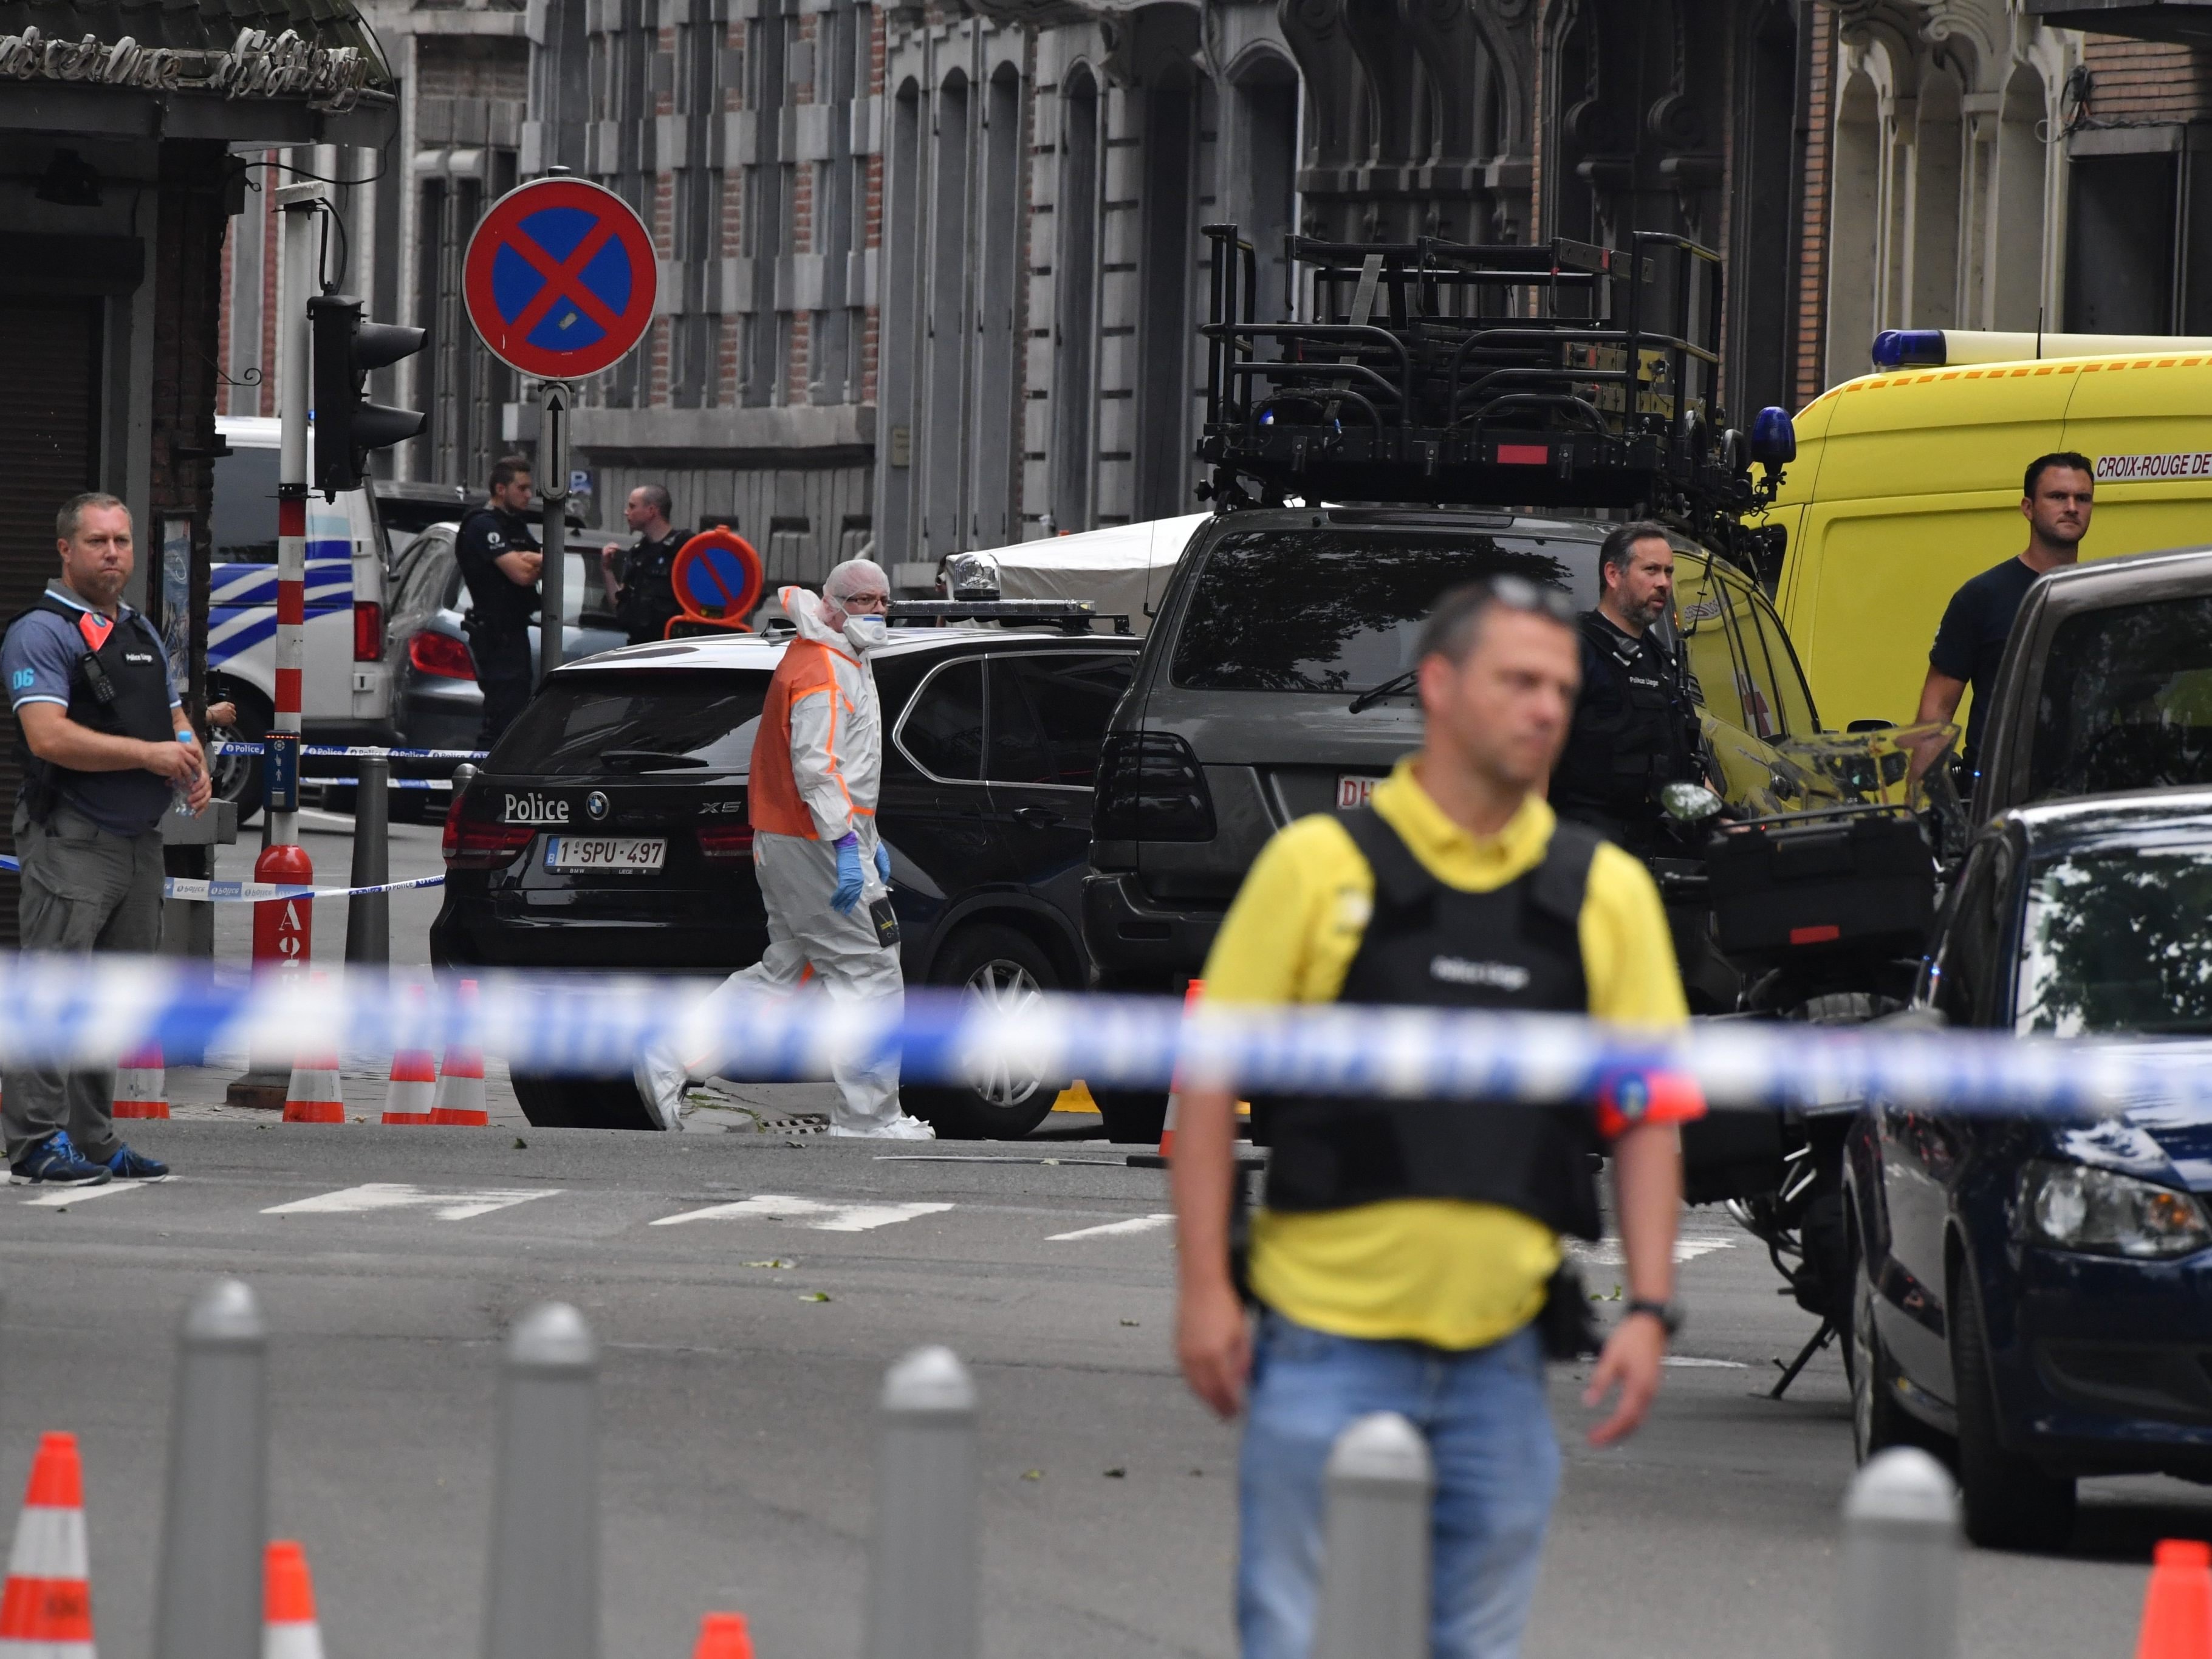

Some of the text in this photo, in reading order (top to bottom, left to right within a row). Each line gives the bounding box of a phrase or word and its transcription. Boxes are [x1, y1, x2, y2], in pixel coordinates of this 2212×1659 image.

[2097, 453, 2212, 478] CROIX-ROUGE DE
[13, 668, 35, 690] 06
[235, 745, 260, 753] Police
[505, 793, 569, 820] Police
[698, 801, 742, 814] X5
[547, 853, 555, 863] B
